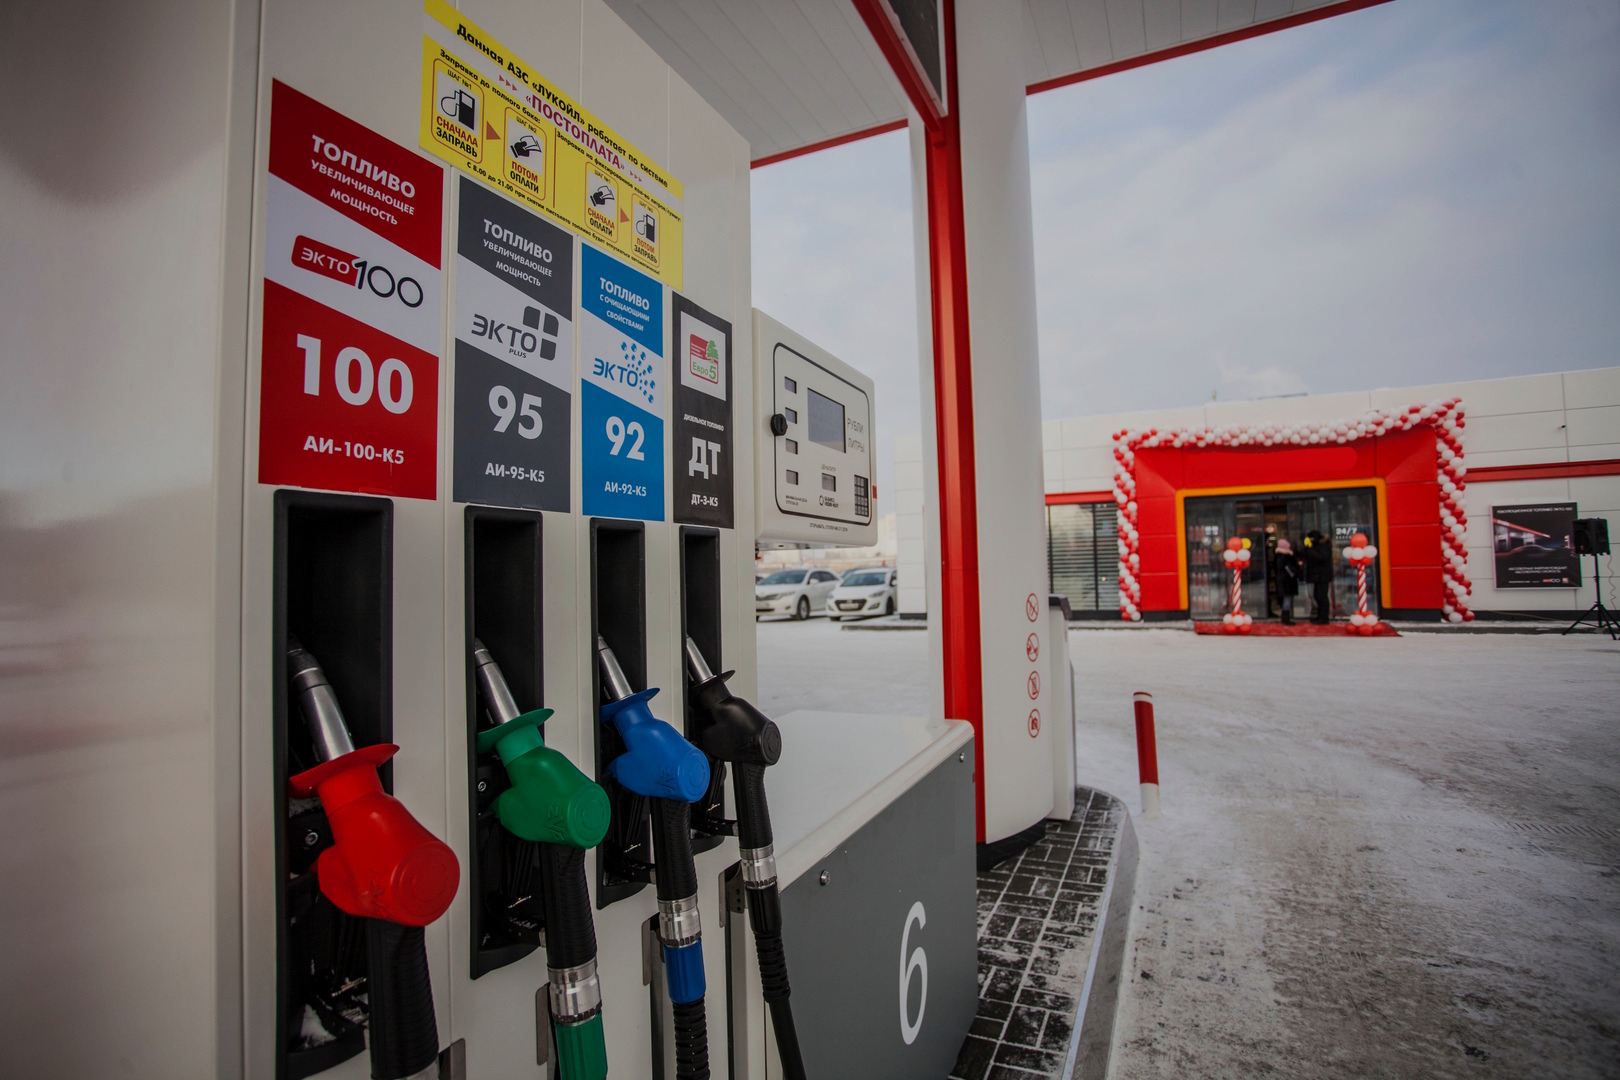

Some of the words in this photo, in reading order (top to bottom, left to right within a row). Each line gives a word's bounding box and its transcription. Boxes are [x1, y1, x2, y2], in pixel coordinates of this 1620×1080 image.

[440, 49, 478, 81] Заправка
[480, 79, 490, 89] до
[492, 86, 521, 110] полного
[522, 105, 541, 124] бака:
[447, 69, 461, 82] ШАГ
[462, 79, 472, 90] №1
[456, 23, 504, 66] Данная
[507, 62, 529, 84] АЗС
[532, 82, 585, 125] «ЛУКОЙЛ»
[587, 122, 626, 156] работает
[628, 152, 638, 165] по
[640, 162, 668, 188] системе
[436, 116, 478, 148] СНАЧАЛА
[516, 116, 527, 127] ШАГ
[525, 95, 625, 170] «ПОСТОПЛАТА»
[436, 127, 478, 158] ЗАПРАВЬ
[311, 134, 416, 199] ТОПЛИВО
[511, 161, 538, 183] ПОТОМ
[556, 130, 584, 156] Заправка
[586, 152, 592, 161] на
[594, 157, 633, 188] фиксированное
[311, 159, 415, 216] УВЕЛИЧИВАЮЩЕЕ
[472, 164, 487, 177] 8.00
[487, 174, 497, 183] до
[497, 179, 514, 192] 21.00
[514, 189, 526, 200] при
[526, 196, 545, 210] снятии
[510, 171, 539, 194] ОПЛАТИ
[330, 188, 398, 226] МОЩНОСТЬ
[587, 207, 615, 230] СНАЧАЛА
[483, 218, 553, 263] ТОПЛИВО
[589, 218, 613, 237] ОПЛАТИ
[483, 239, 553, 278] УВЕЛИЧИВАЮЩЕЕ
[634, 244, 658, 264] ЗАПРАВЬ
[636, 237, 655, 254] ПОТОМ
[495, 261, 542, 287] МОЩНОСТЬ
[600, 276, 650, 311] ТОПЛИВО
[600, 293, 604, 302] С
[604, 295, 650, 322] ОЧИЩАЮЩИМИ
[471, 313, 537, 353] ЭКТО
[606, 309, 644, 332] СВОЙСТВАМИ
[509, 348, 527, 359] PLUS
[296, 333, 414, 415] 100
[593, 357, 639, 388] ЭКТО
[692, 361, 709, 376] Евро
[709, 365, 717, 380] 5
[488, 385, 544, 440] 95
[303, 435, 405, 465] АИ-100-К5
[605, 415, 645, 462] 92
[485, 462, 546, 484] АИ-95-К5
[688, 436, 721, 480] ДТ
[604, 480, 647, 497] АИ-92-К5
[899, 901, 928, 1046] 6
